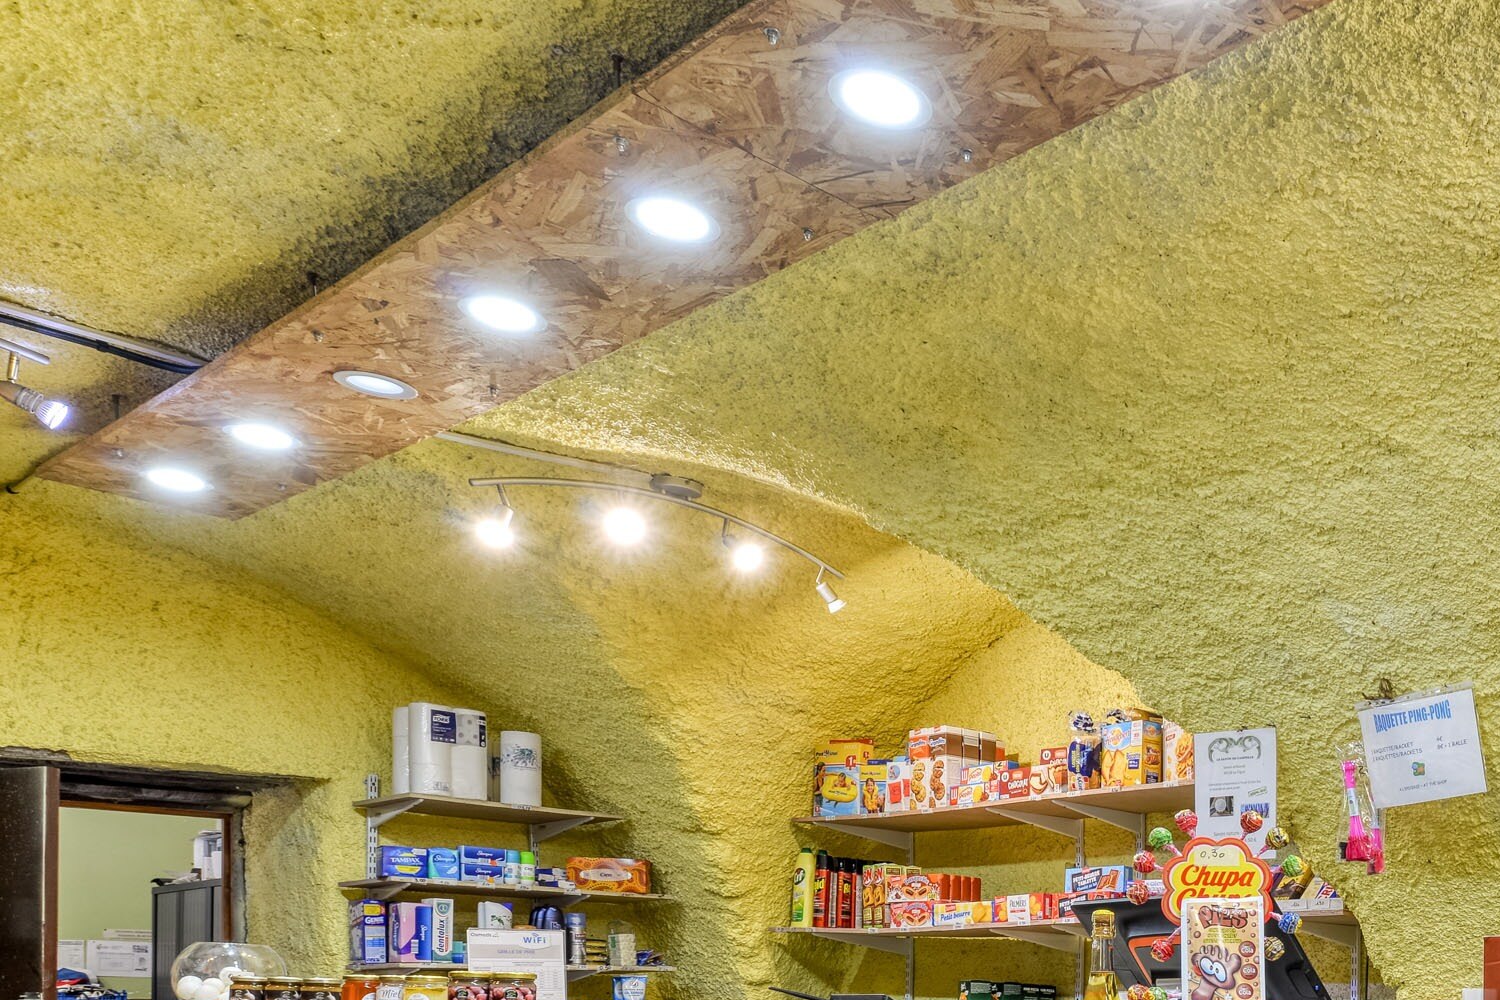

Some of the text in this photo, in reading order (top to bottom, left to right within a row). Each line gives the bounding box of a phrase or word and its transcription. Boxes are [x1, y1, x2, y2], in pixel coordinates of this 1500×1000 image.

[1373, 699, 1452, 733] RAQUETTE PING-PONG
[390, 856, 421, 865] TAMPAX
[1180, 865, 1256, 894] Chupa
[953, 909, 971, 920] beurre
[436, 916, 448, 955] dentalux
[523, 933, 547, 945] WiFi
[381, 988, 402, 999] Miel
